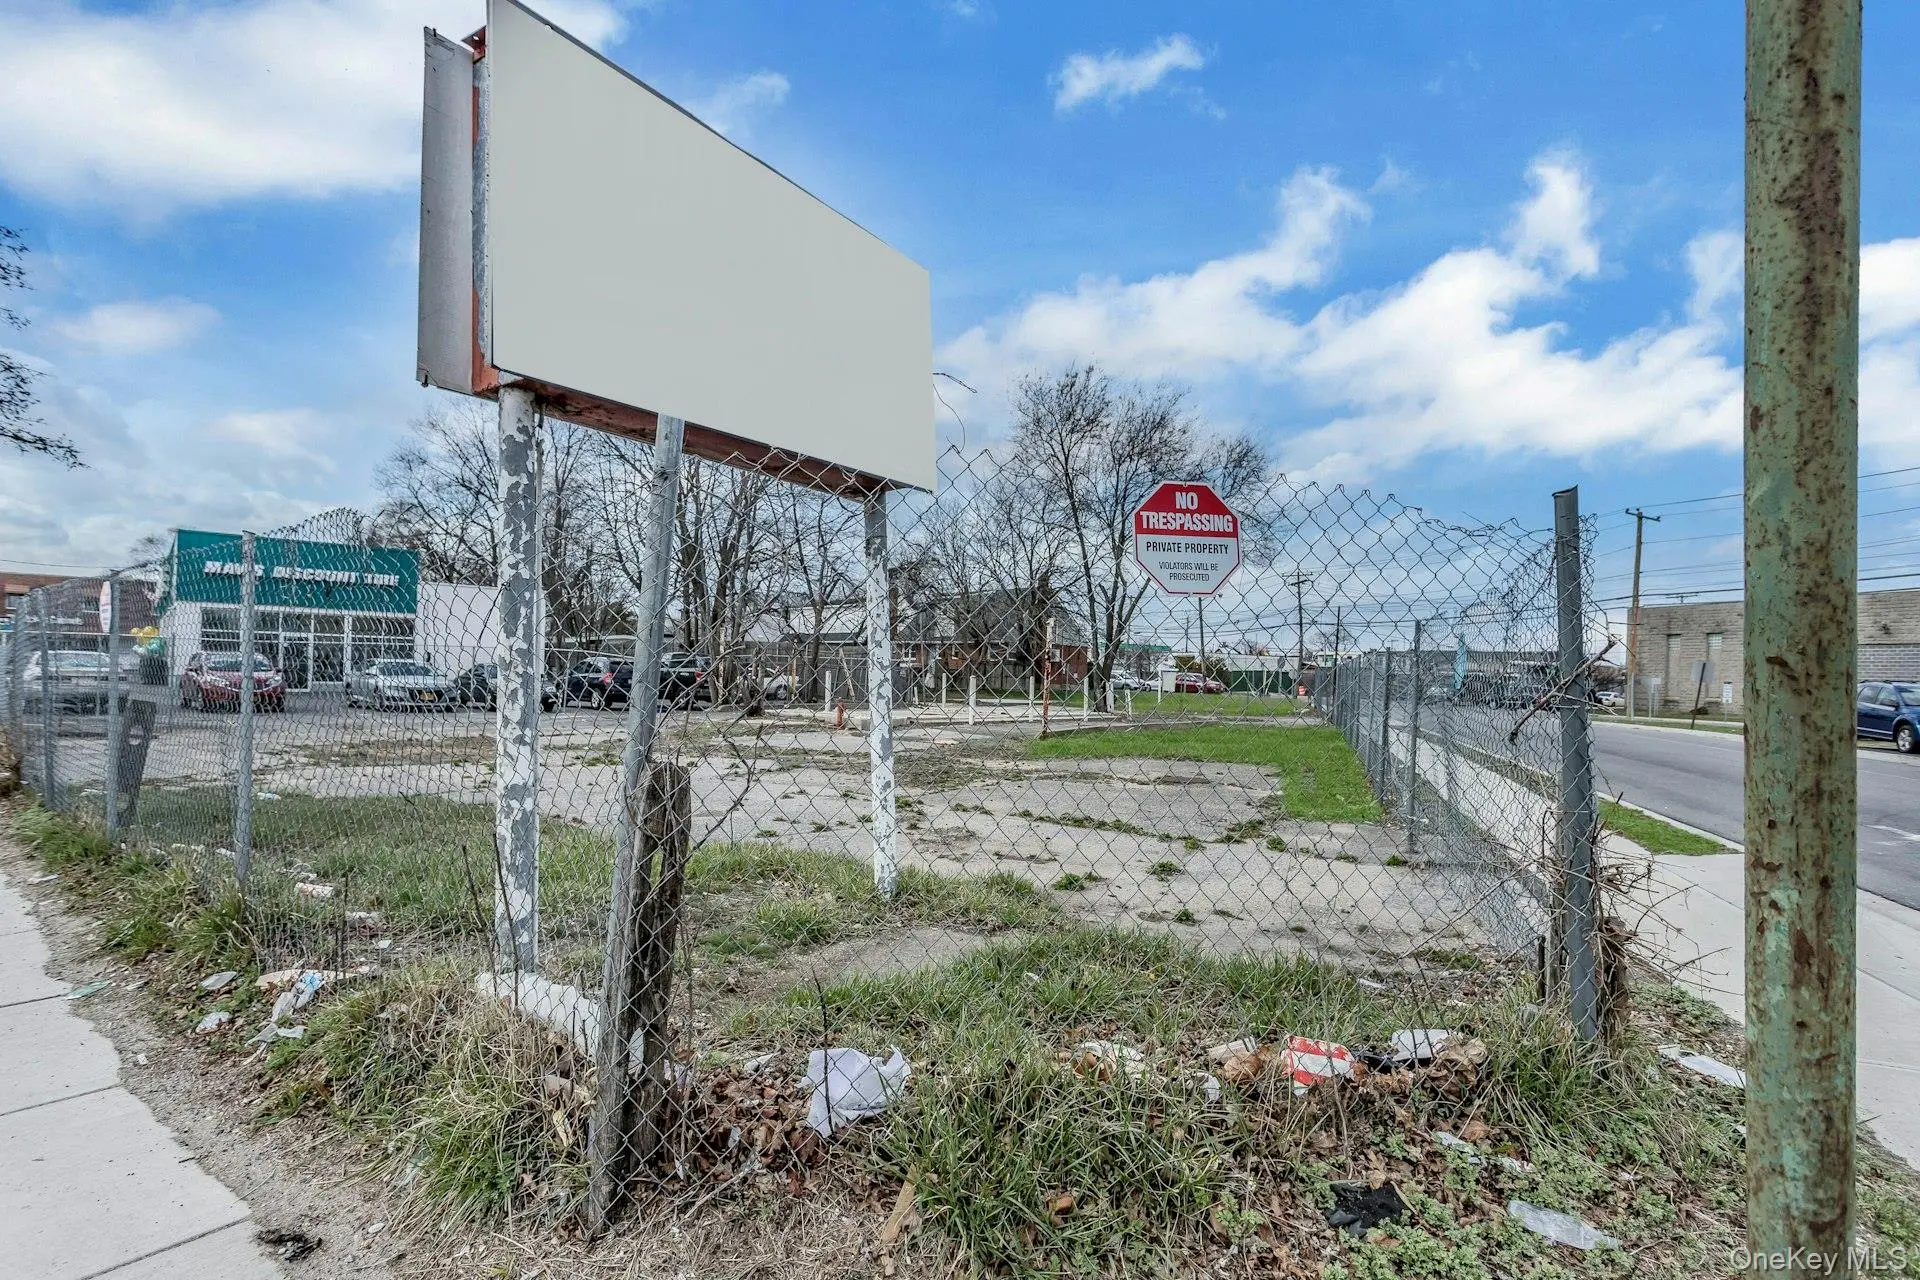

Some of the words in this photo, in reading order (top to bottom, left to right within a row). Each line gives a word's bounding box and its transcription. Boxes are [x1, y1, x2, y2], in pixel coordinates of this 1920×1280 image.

[1175, 491, 1199, 510] NO
[1140, 511, 1233, 532] TRESPASSING
[1146, 541, 1182, 553] PRIVATE
[1185, 542, 1229, 554] PROPERTY
[1159, 561, 1193, 570] VIOLATORS
[1194, 562, 1210, 571] WILL
[1210, 563, 1219, 571] BE
[1169, 573, 1210, 581] PROSECUTED
